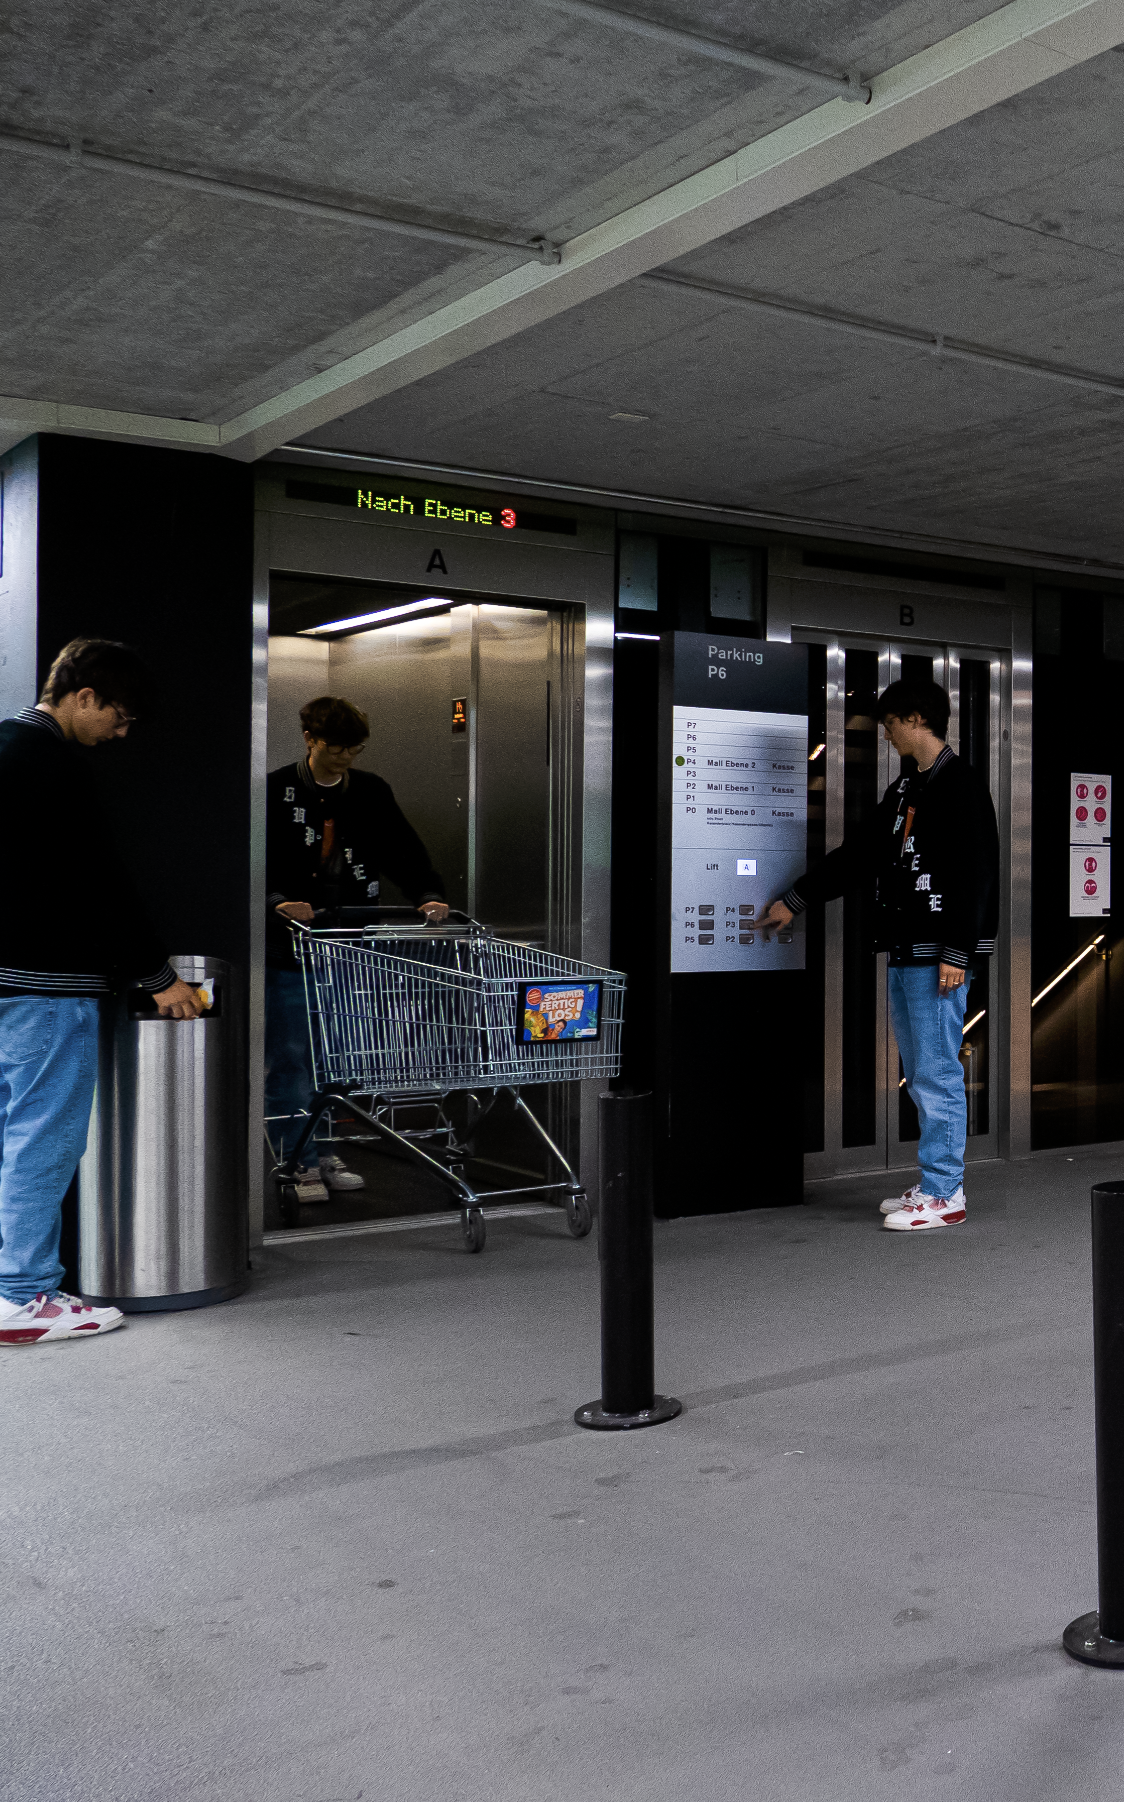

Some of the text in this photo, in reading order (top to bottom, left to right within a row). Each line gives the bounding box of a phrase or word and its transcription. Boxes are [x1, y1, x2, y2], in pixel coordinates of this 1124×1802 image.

[357, 489, 517, 529] Nach Ebene 3
[426, 548, 449, 575] A
[899, 604, 915, 627] B
[708, 645, 763, 665] Parking
[708, 665, 727, 679] P6
[686, 721, 697, 729] P7
[686, 733, 697, 741] P6
[686, 746, 697, 754] P5
[686, 758, 795, 771] P4 Mall Ebene 2 Kasse
[686, 770, 697, 778] P3
[686, 782, 697, 790] P2
[707, 783, 723, 791] Mall
[725, 784, 749, 792] Ebene
[772, 786, 795, 794] Kasse
[686, 794, 696, 802] P1
[686, 806, 697, 814] P0
[706, 807, 722, 815] Mall
[724, 808, 748, 816] Ebene
[771, 809, 795, 818] Kasse
[706, 863, 719, 871] Lift
[685, 906, 695, 914] P7
[725, 906, 736, 914] P4
[685, 921, 695, 929] P6
[725, 921, 736, 929] P3
[725, 935, 736, 943] P2
[543, 989, 584, 1001] SOMMER
[540, 998, 576, 1012] FERTIG
